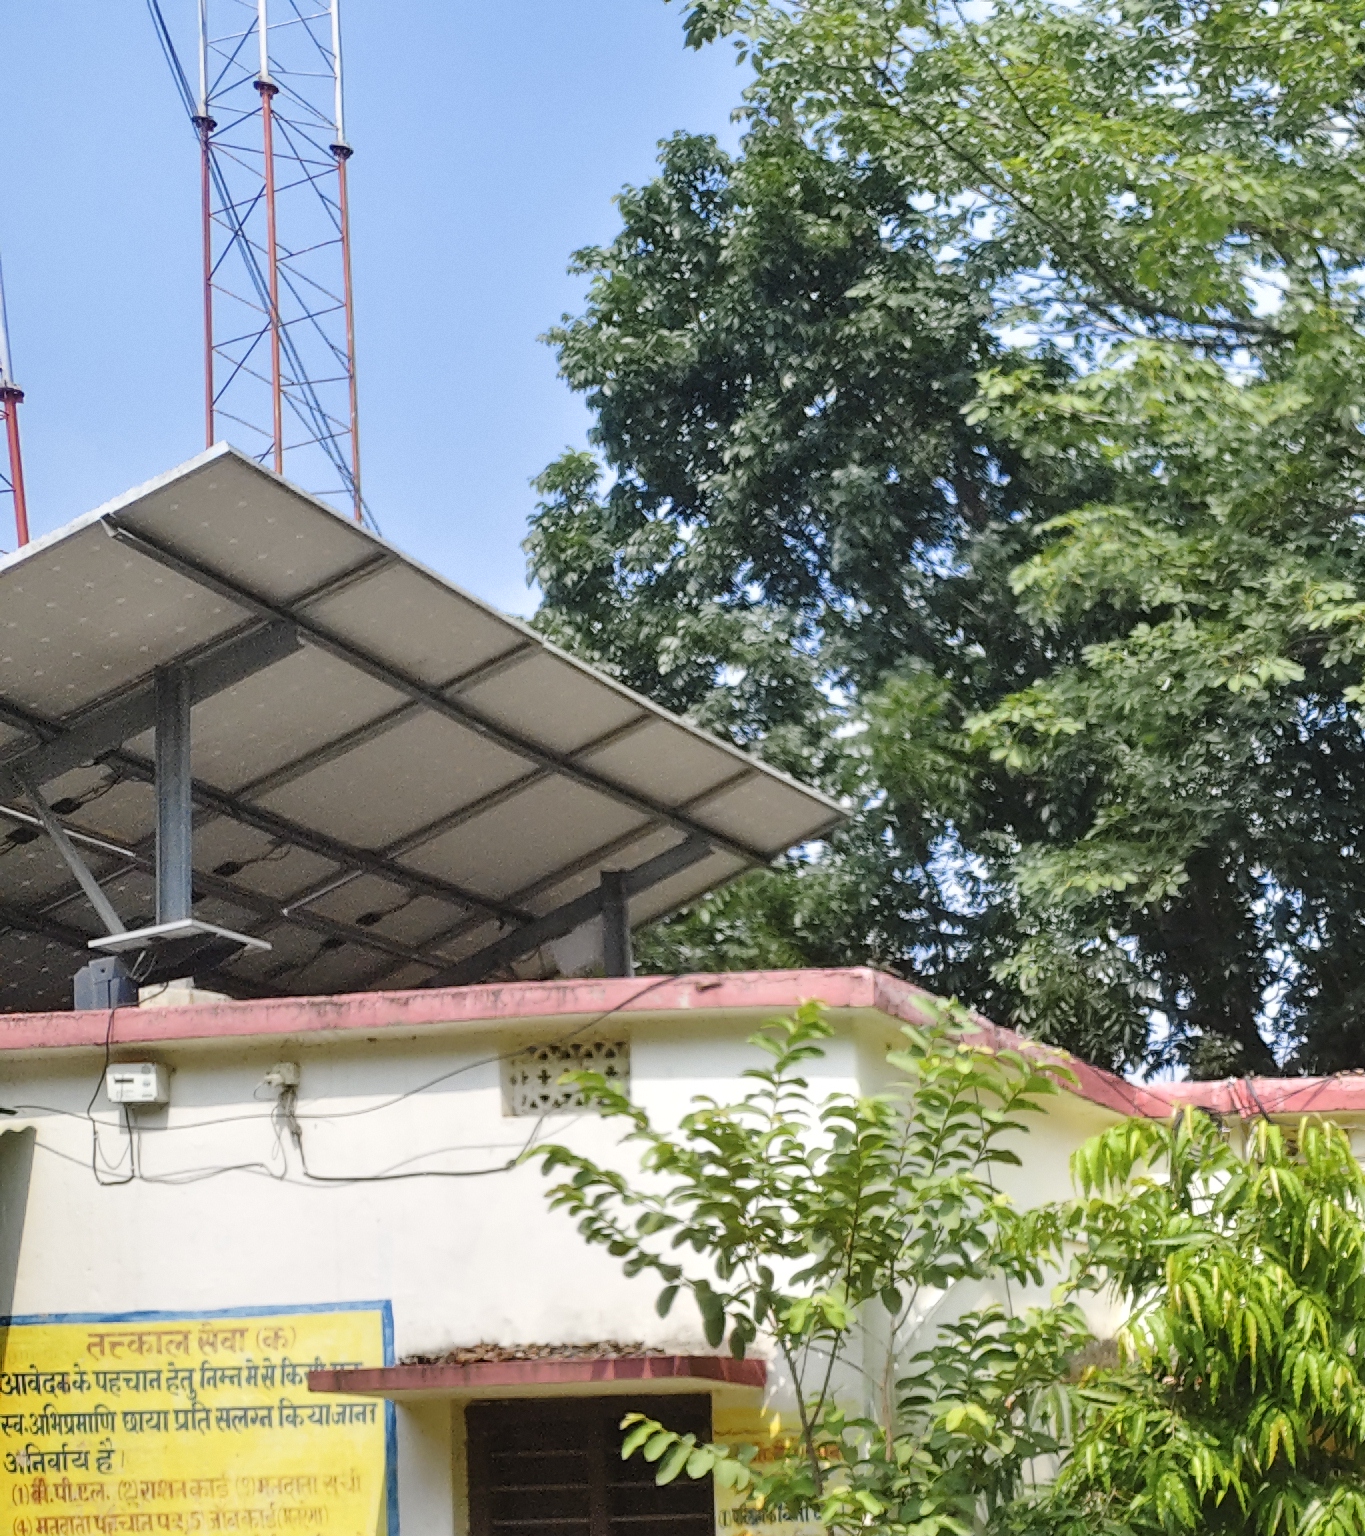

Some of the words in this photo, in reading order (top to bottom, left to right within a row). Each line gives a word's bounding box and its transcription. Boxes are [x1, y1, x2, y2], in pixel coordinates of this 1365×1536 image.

[198, 1322, 249, 1355] सेवा
[256, 1326, 297, 1351] (क)
[72, 1362, 92, 1394] के
[93, 1368, 163, 1398] पहचान
[166, 1361, 198, 1402] हेतु
[200, 1360, 243, 1390] निम्न
[262, 1357, 277, 1390] से
[121, 1410, 170, 1435] छाया
[173, 1400, 212, 1436] प्रति
[216, 1406, 275, 1434] सलग्न
[279, 1398, 331, 1428] किया
[332, 1403, 378, 1427] जाना
[139, 1479, 187, 1503] राशन
